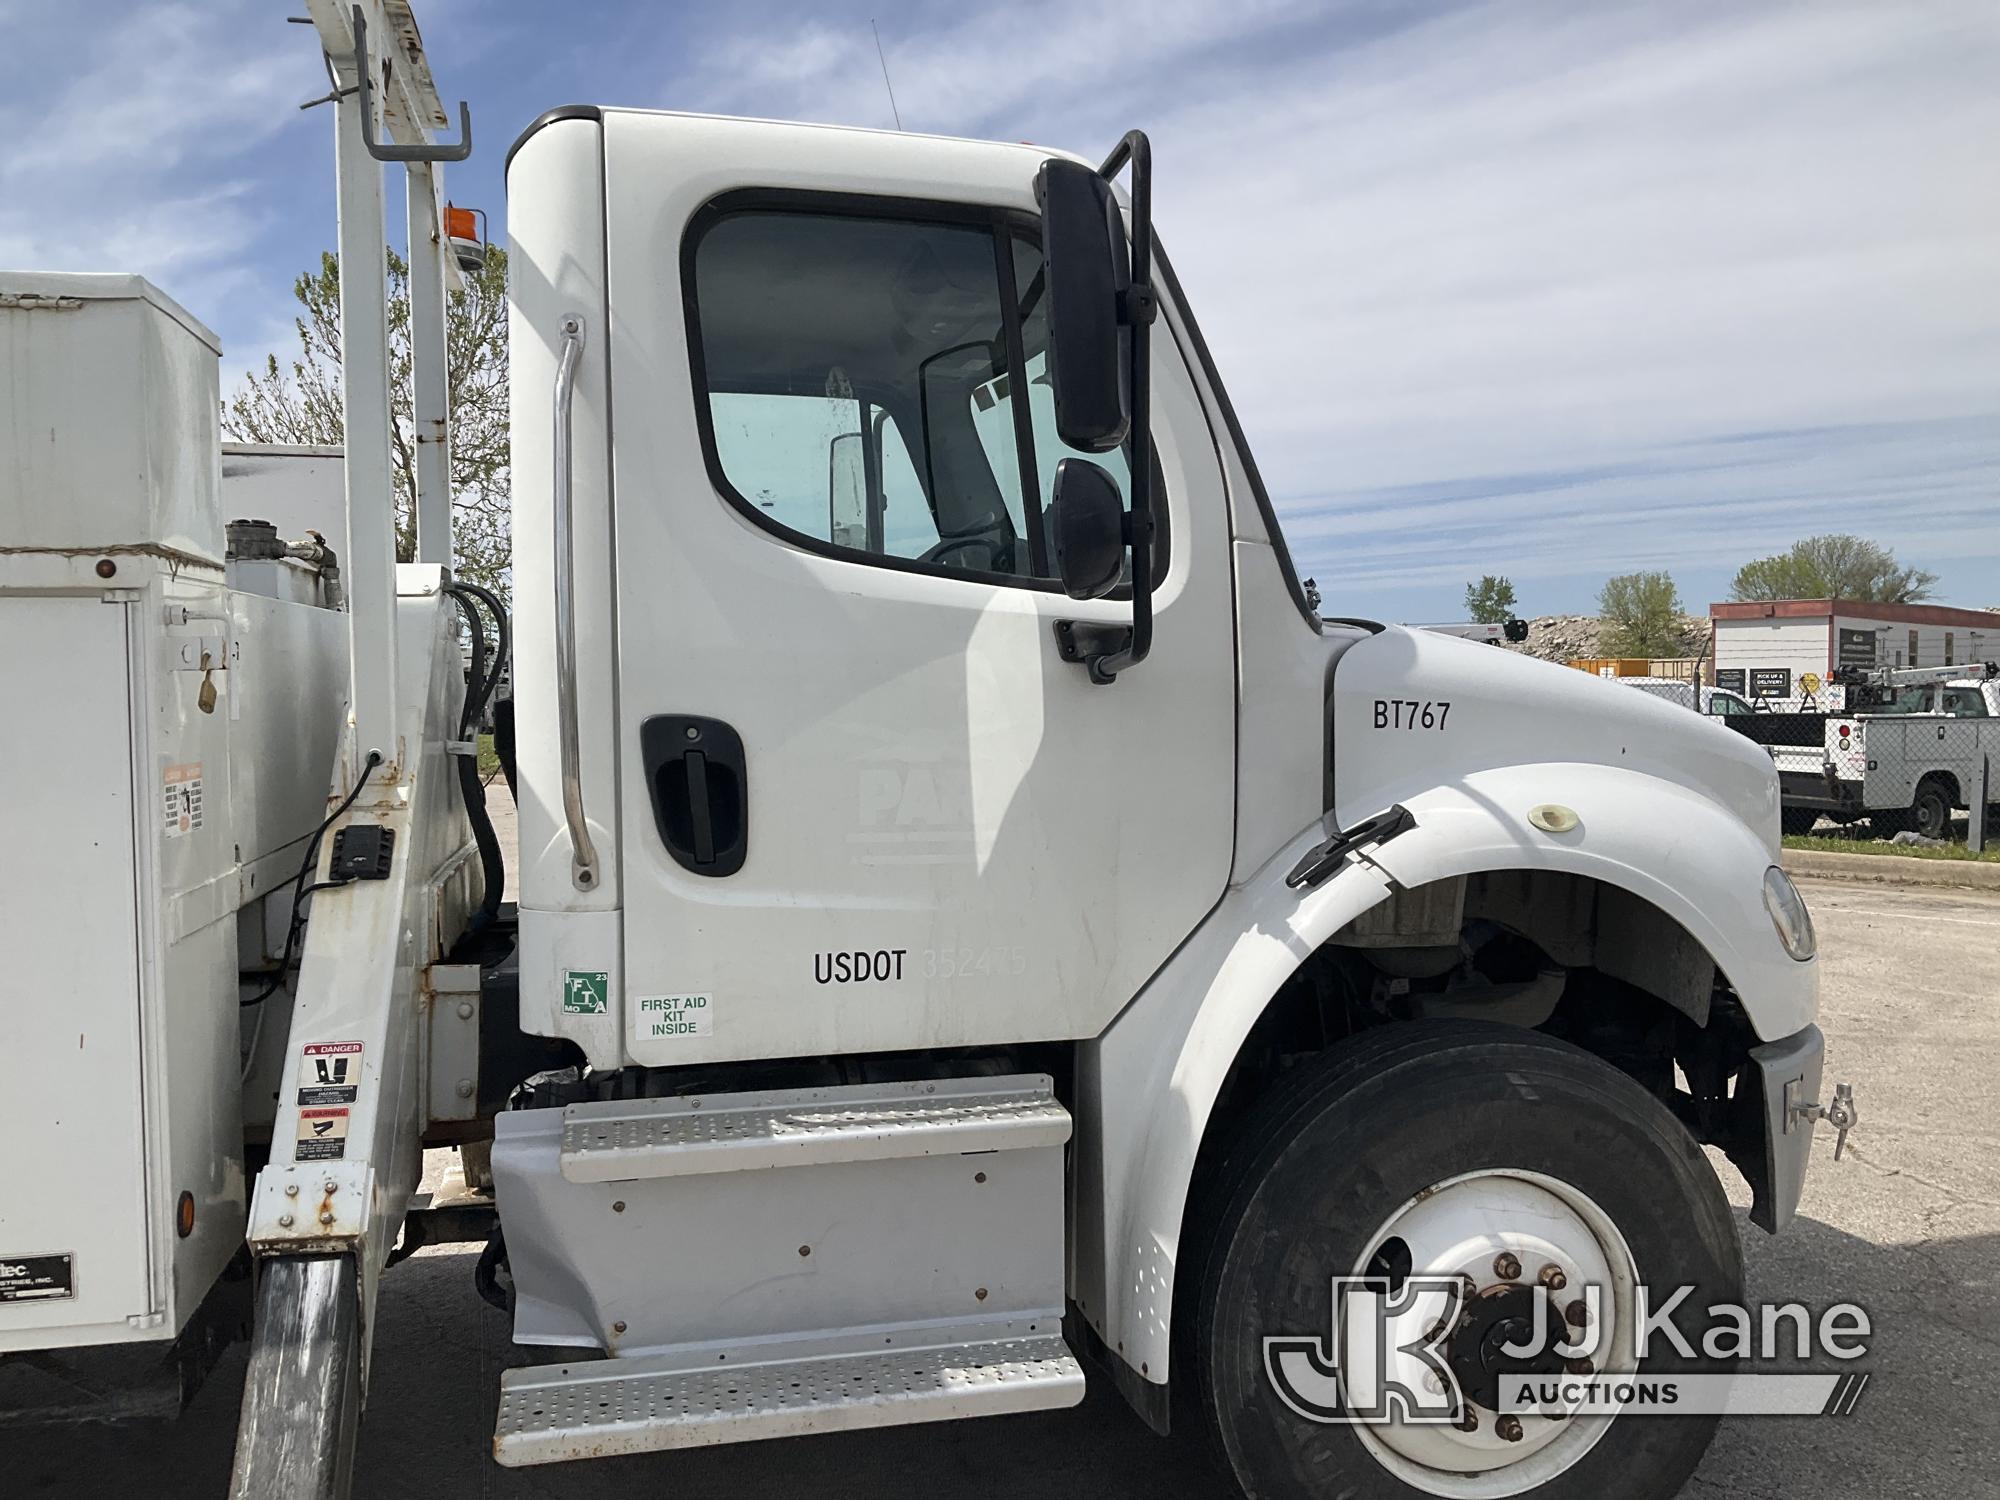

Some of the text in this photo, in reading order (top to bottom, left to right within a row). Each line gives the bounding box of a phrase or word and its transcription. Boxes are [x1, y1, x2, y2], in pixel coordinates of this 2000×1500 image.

[1374, 699, 1451, 731] BT767
[815, 949, 907, 984] USDOT
[595, 973, 608, 981] 23
[564, 1004, 580, 1013] MO
[641, 997, 707, 1011] FIRST AID
[664, 1011, 685, 1022] KIT
[652, 1022, 697, 1036] INSIDE
[320, 1044, 360, 1054] DANGER
